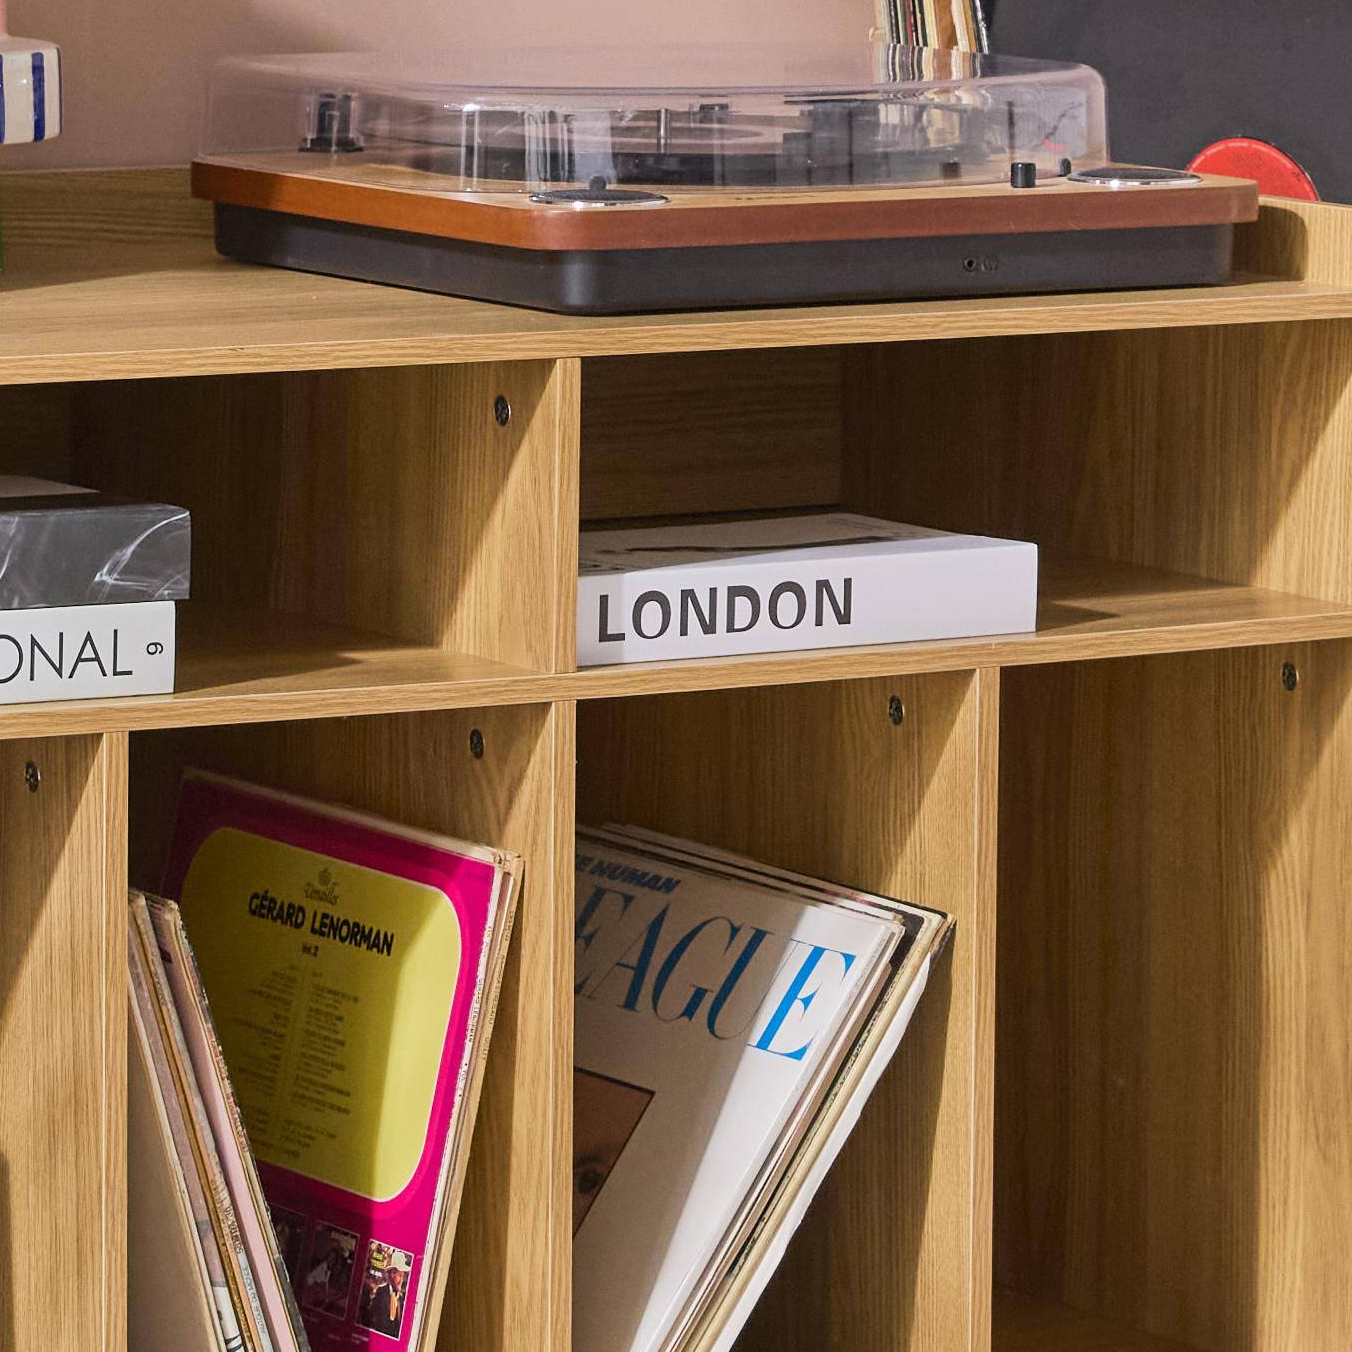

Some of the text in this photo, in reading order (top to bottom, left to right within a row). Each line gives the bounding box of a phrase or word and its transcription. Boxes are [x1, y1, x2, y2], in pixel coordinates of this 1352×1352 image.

[598, 577, 853, 642] LONDON
[589, 859, 682, 894] HUMAN
[248, 888, 395, 957] GÉRARD LENORMAN
[575, 884, 857, 1061] EAGUE
